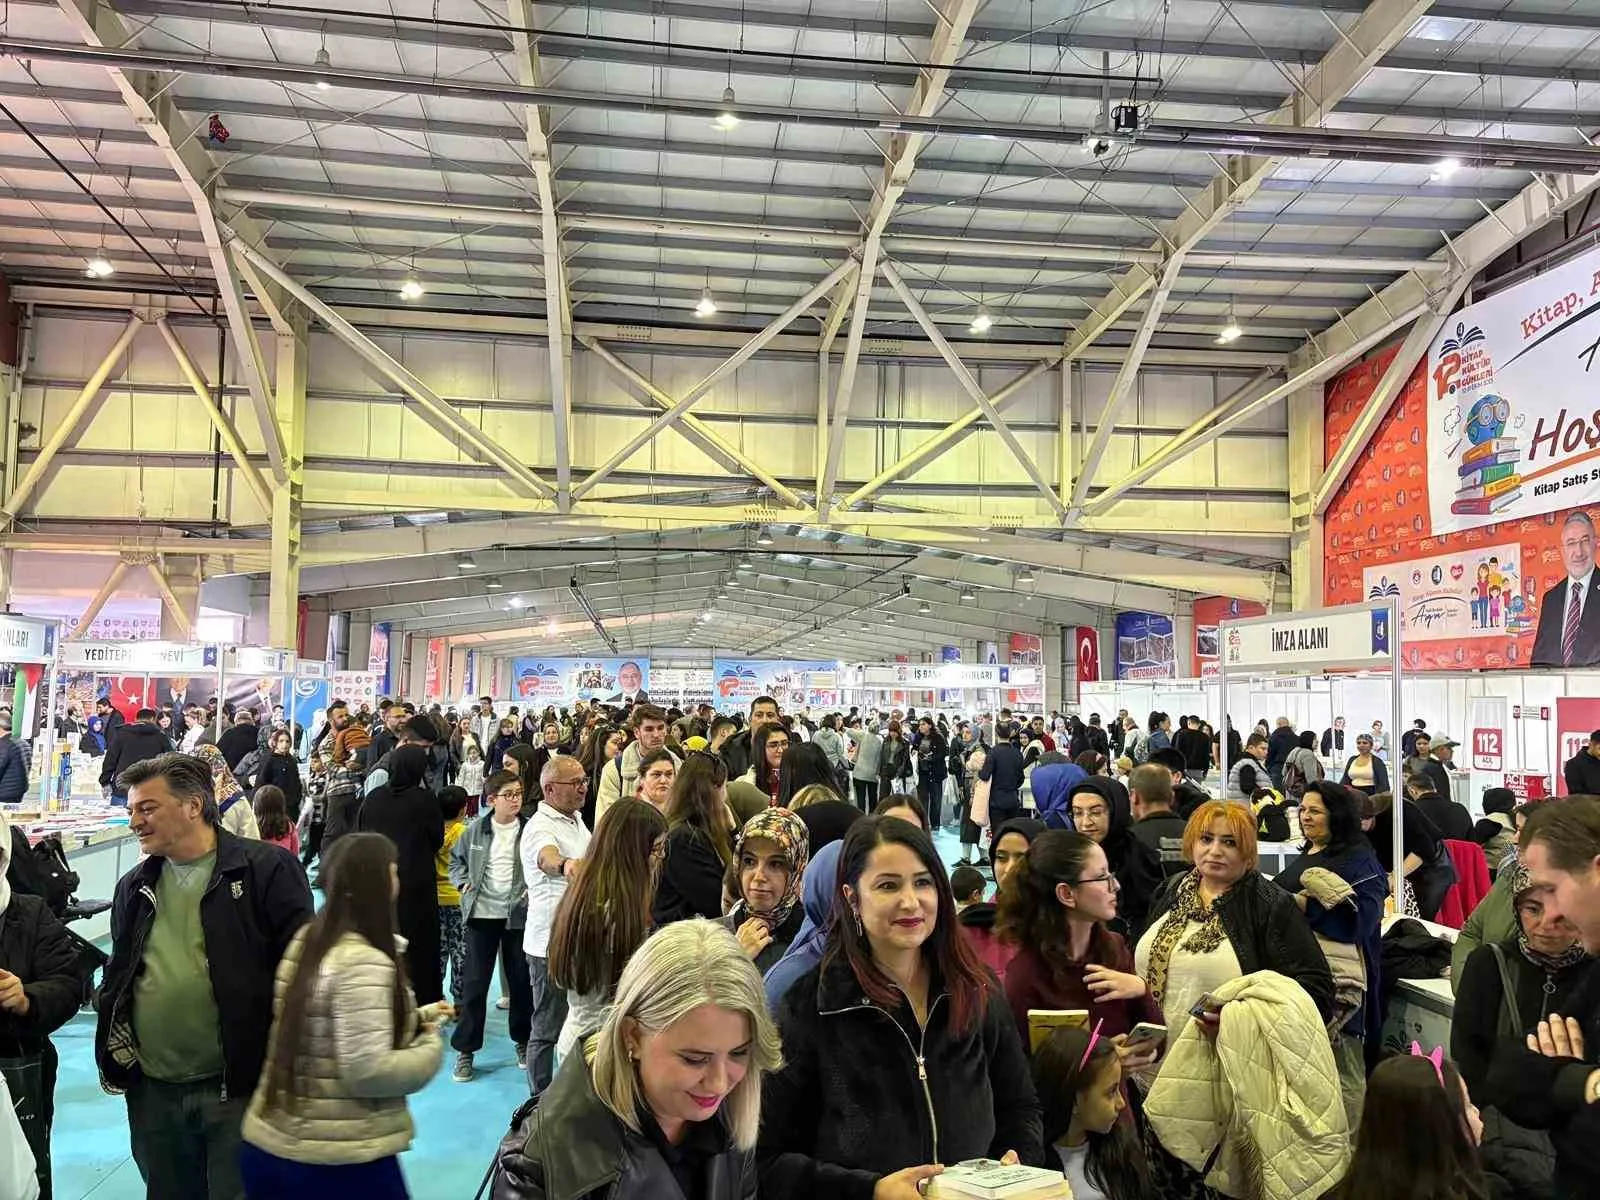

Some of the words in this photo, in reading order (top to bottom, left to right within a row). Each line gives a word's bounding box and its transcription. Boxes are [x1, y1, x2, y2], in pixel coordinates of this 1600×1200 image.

[1521, 292, 1584, 339] Kitap,
[1534, 484, 1560, 496] Kitap
[1562, 473, 1588, 488] Satış
[1271, 628, 1295, 651] İMZA
[1298, 627, 1329, 650] ALANI
[1476, 733, 1499, 754] 112
